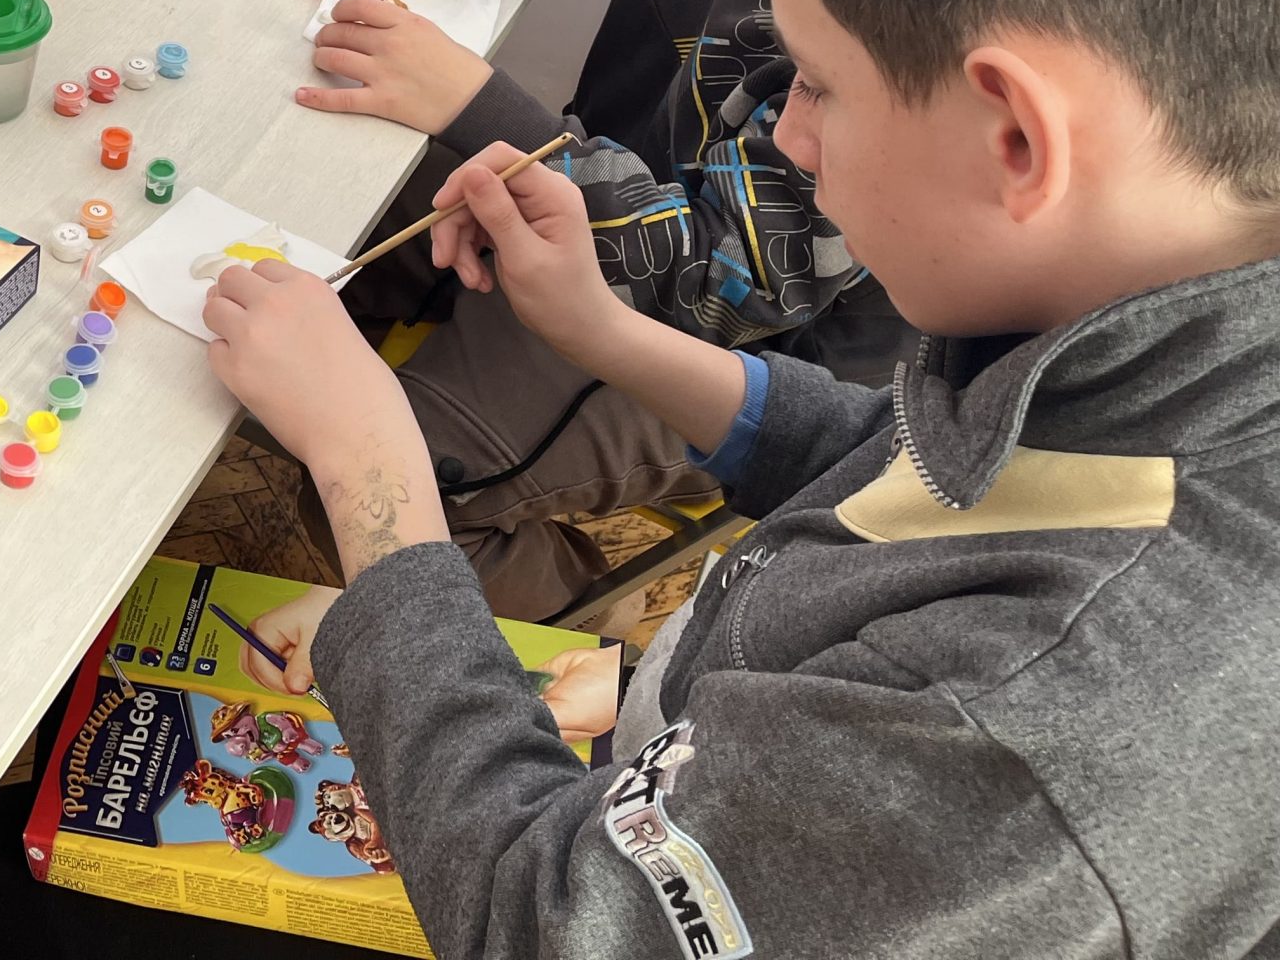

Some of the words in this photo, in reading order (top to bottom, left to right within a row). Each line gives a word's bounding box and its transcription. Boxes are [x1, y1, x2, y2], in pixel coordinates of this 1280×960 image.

[177, 626, 190, 652] ФОРМА
[186, 597, 198, 622] КЛІШЕ
[200, 663, 211, 671] 6
[62, 689, 124, 818] Розписний
[89, 720, 124, 788] Гіпсовий
[95, 691, 159, 829] БАРЕЛЬЄФ
[141, 714, 174, 792] магнітах
[134, 790, 151, 814] на
[48, 853, 101, 874] ОПЕРЕДЖЕННЯ
